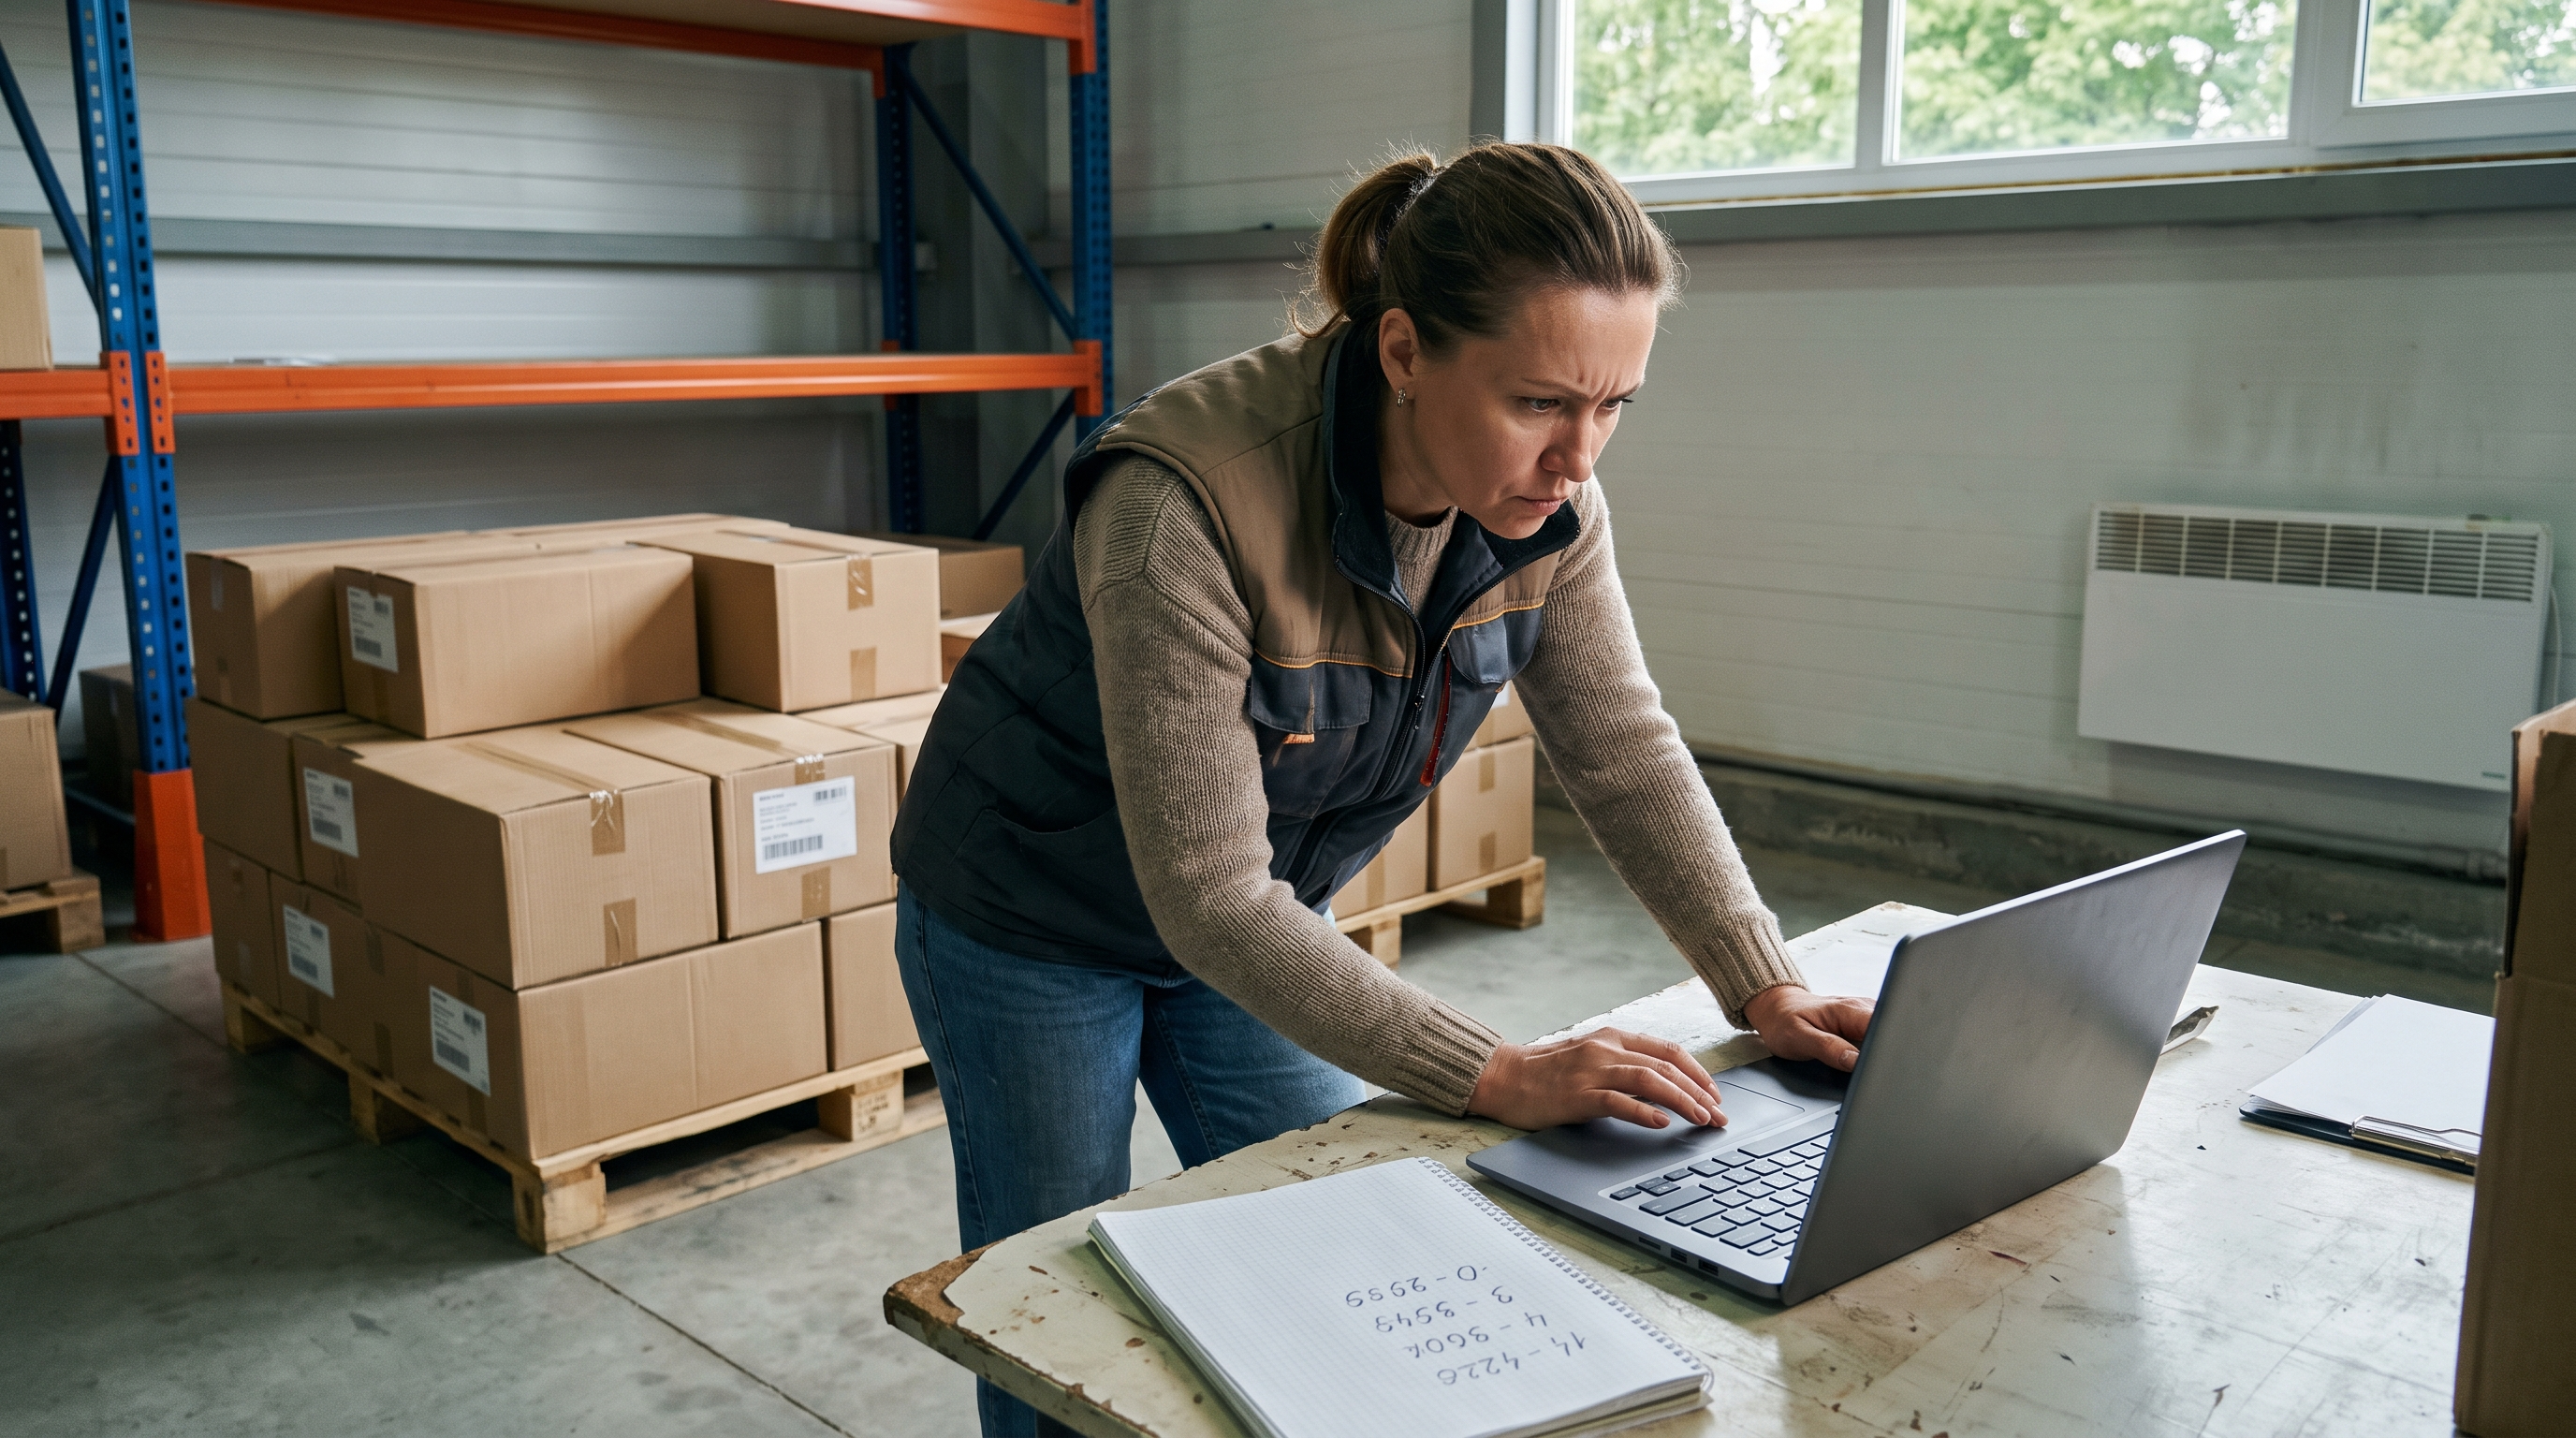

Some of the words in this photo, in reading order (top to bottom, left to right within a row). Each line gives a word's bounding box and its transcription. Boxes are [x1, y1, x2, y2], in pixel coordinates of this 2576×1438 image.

[1491, 1285, 1513, 1304] 3
[1524, 1312, 1547, 1328] 4
[1550, 1331, 1587, 1357] 14
